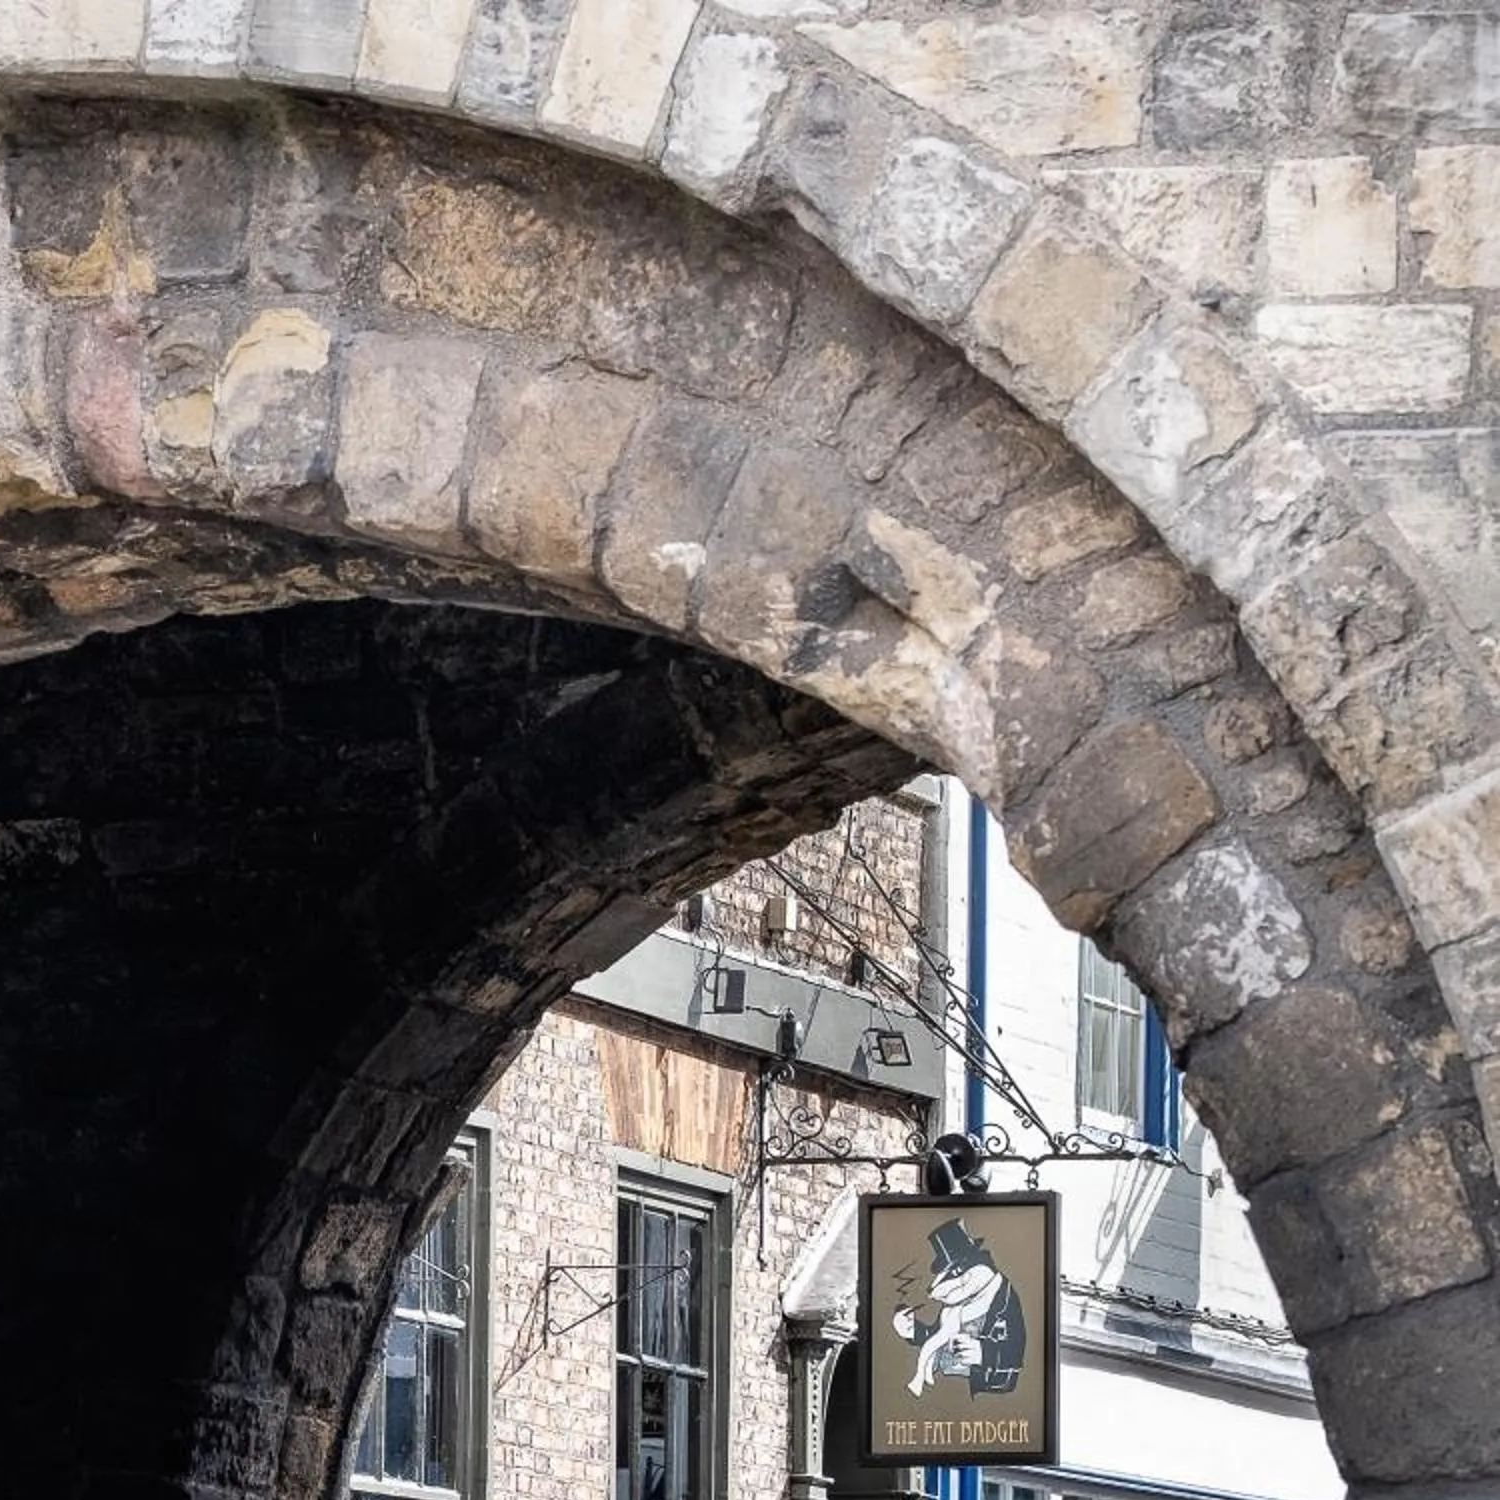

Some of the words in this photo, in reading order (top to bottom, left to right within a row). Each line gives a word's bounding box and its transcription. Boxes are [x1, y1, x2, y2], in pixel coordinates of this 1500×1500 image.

[885, 1421, 917, 1445] THE
[923, 1421, 954, 1445] FAT
[959, 1418, 1029, 1445] BADGER
